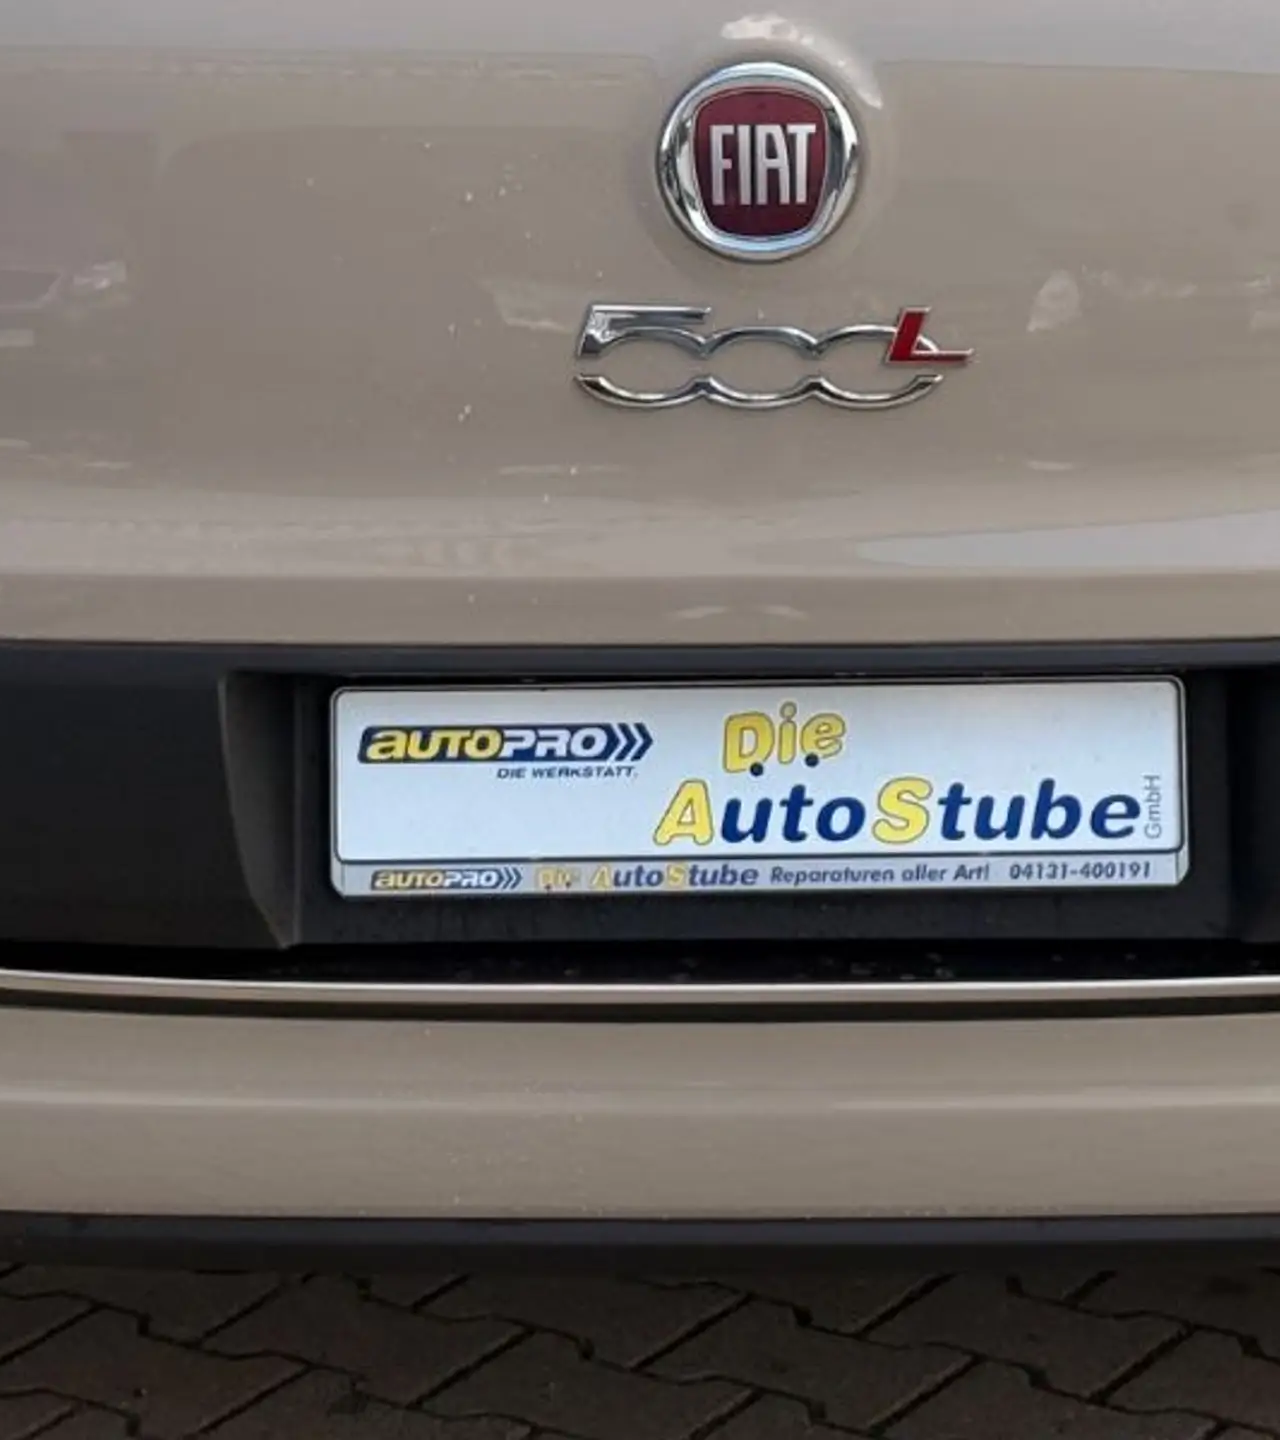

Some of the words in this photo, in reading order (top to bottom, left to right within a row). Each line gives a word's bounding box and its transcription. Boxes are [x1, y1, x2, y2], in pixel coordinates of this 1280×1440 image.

[709, 123, 817, 206] FIAT
[574, 303, 976, 410] 500L
[723, 701, 847, 774] Die
[497, 767, 526, 779] DIE
[1144, 774, 1162, 839] GmbH
[653, 776, 1141, 845] AutoStube
[589, 863, 759, 889] AutoStube
[770, 865, 894, 886] Reparaturen
[901, 864, 947, 881] aller
[953, 863, 990, 880] Art!
[1008, 862, 1152, 880] 04131-400191
